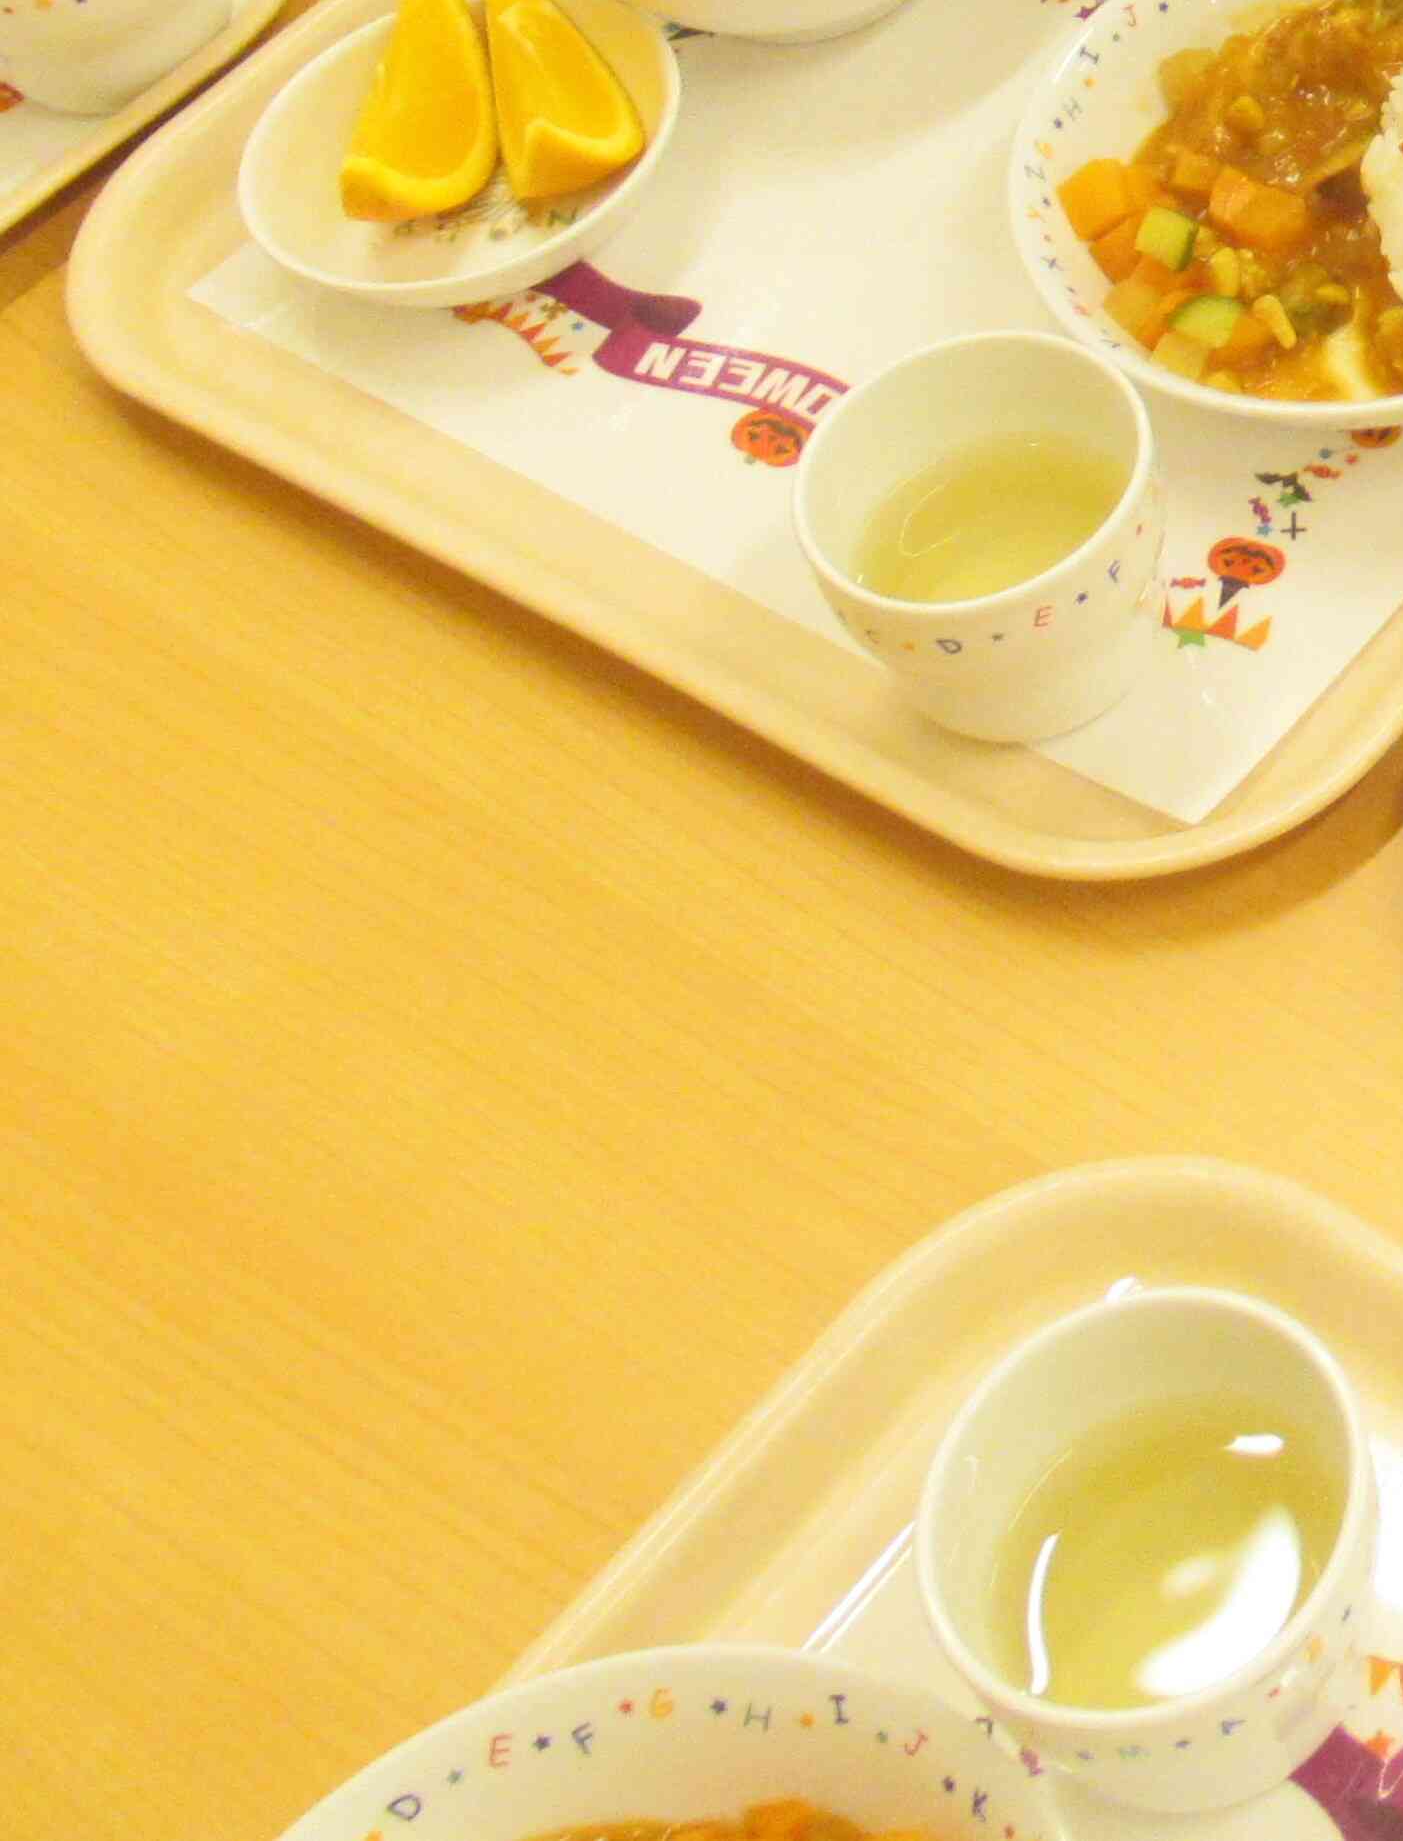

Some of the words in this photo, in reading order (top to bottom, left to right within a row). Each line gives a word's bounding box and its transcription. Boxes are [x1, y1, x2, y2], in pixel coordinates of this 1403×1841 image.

[635, 342, 843, 420] OWEEN
[936, 637, 963, 656] D
[1033, 605, 1053, 628] E
[387, 1794, 421, 1821] D
[489, 1733, 512, 1767] E
[571, 1722, 593, 1754] F
[649, 1688, 673, 1718] G
[744, 1702, 772, 1732] H
[829, 1694, 849, 1725] I
[904, 1729, 928, 1757] J
